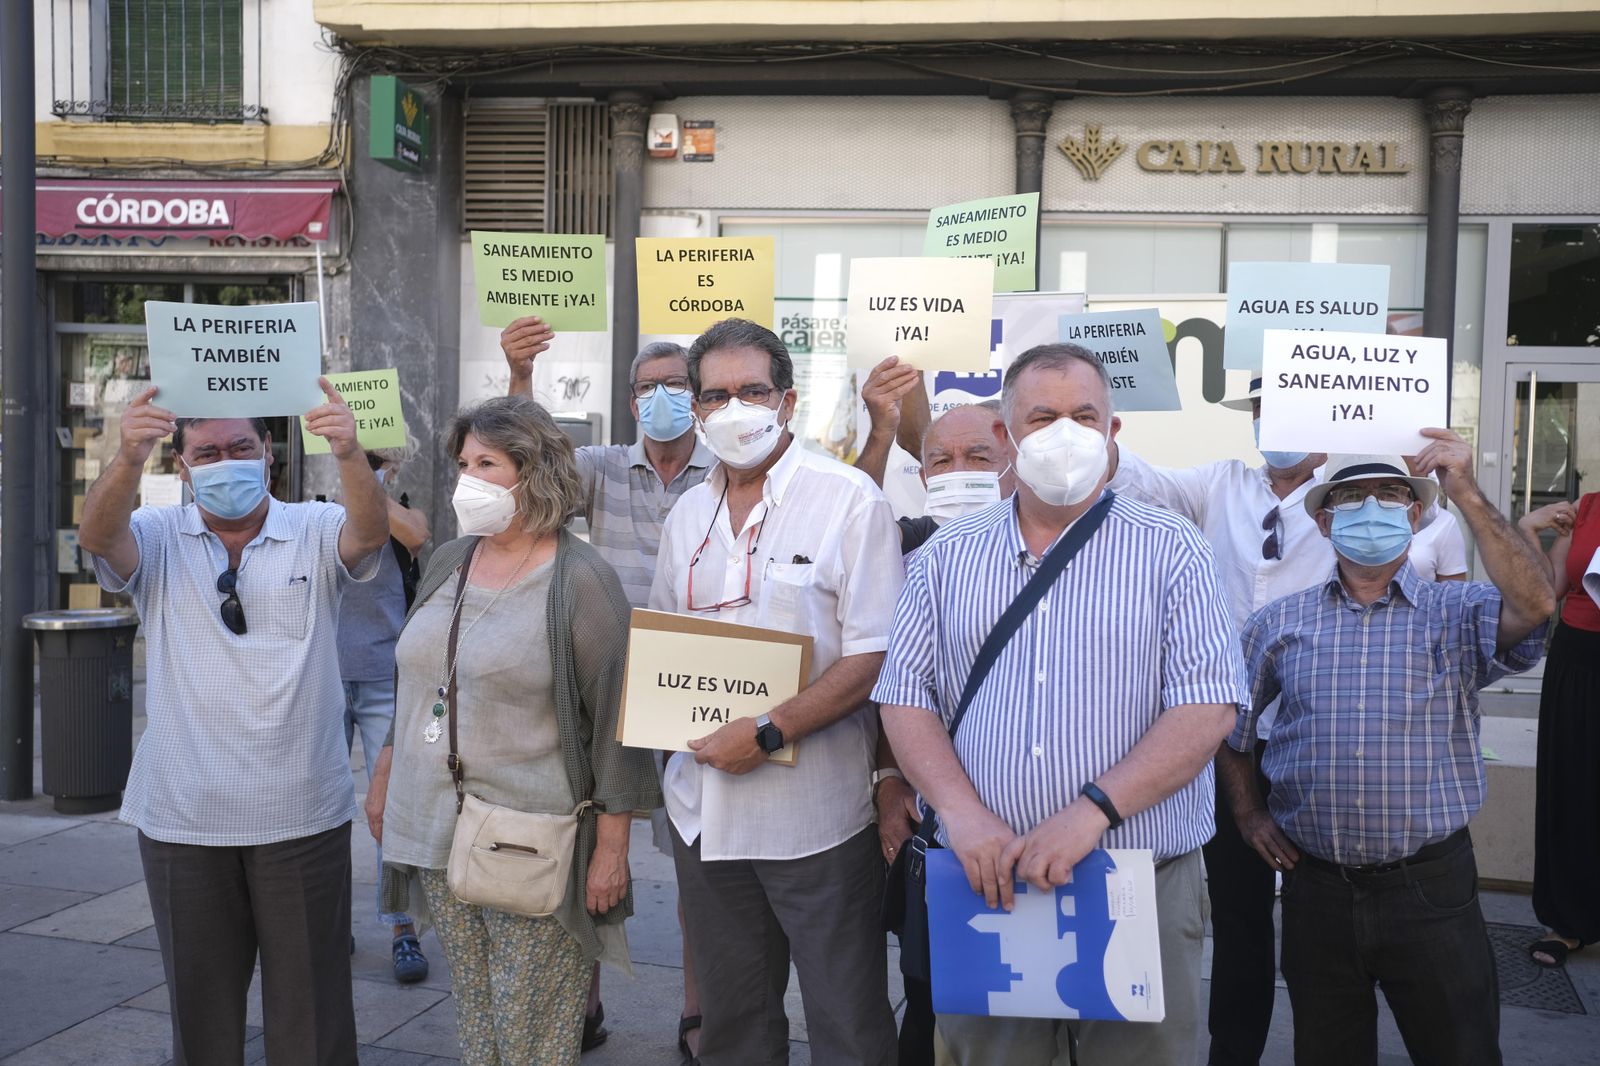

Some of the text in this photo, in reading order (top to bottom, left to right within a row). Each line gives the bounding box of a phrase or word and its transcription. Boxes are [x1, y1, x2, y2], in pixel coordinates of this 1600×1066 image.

[1136, 140, 1410, 175] CAJA RURAL
[76, 193, 230, 225] CÓRDOBA
[935, 205, 1027, 228] SANEAMIENTO
[946, 229, 1008, 247] ES MEDIO
[483, 243, 593, 260] SANEAMIENTO
[656, 248, 755, 262] LA PERIFERIA
[996, 251, 1026, 267] ¡YA!
[502, 268, 574, 283] ES MEDIO
[697, 274, 715, 287] ES
[486, 290, 596, 308] AMBIENTE ¡YA!
[669, 296, 745, 312] CÓRDOBA
[868, 297, 965, 313] LUZ ES VIDA
[1238, 300, 1379, 316] AGUA ES SALUD
[173, 316, 297, 334] LA PERIFERIA
[1069, 322, 1146, 339] LA PERIFERIA
[895, 326, 929, 342] ¡YA!
[191, 345, 280, 363] TAMBIÉN
[1095, 346, 1139, 364] MBIÉN
[1291, 345, 1418, 364] AGUA, LUZ Y
[207, 377, 269, 391] EXISTE
[334, 379, 389, 393] AMIENTO
[1110, 376, 1136, 389] ISTE
[1278, 373, 1430, 393] SANEAMIENTO
[347, 400, 376, 411] EDIO
[1332, 404, 1374, 421] ¡YA!
[369, 416, 395, 430] ¡YA!
[657, 672, 769, 697] LUZ ES VIDA
[691, 706, 730, 723] ¡YA!
